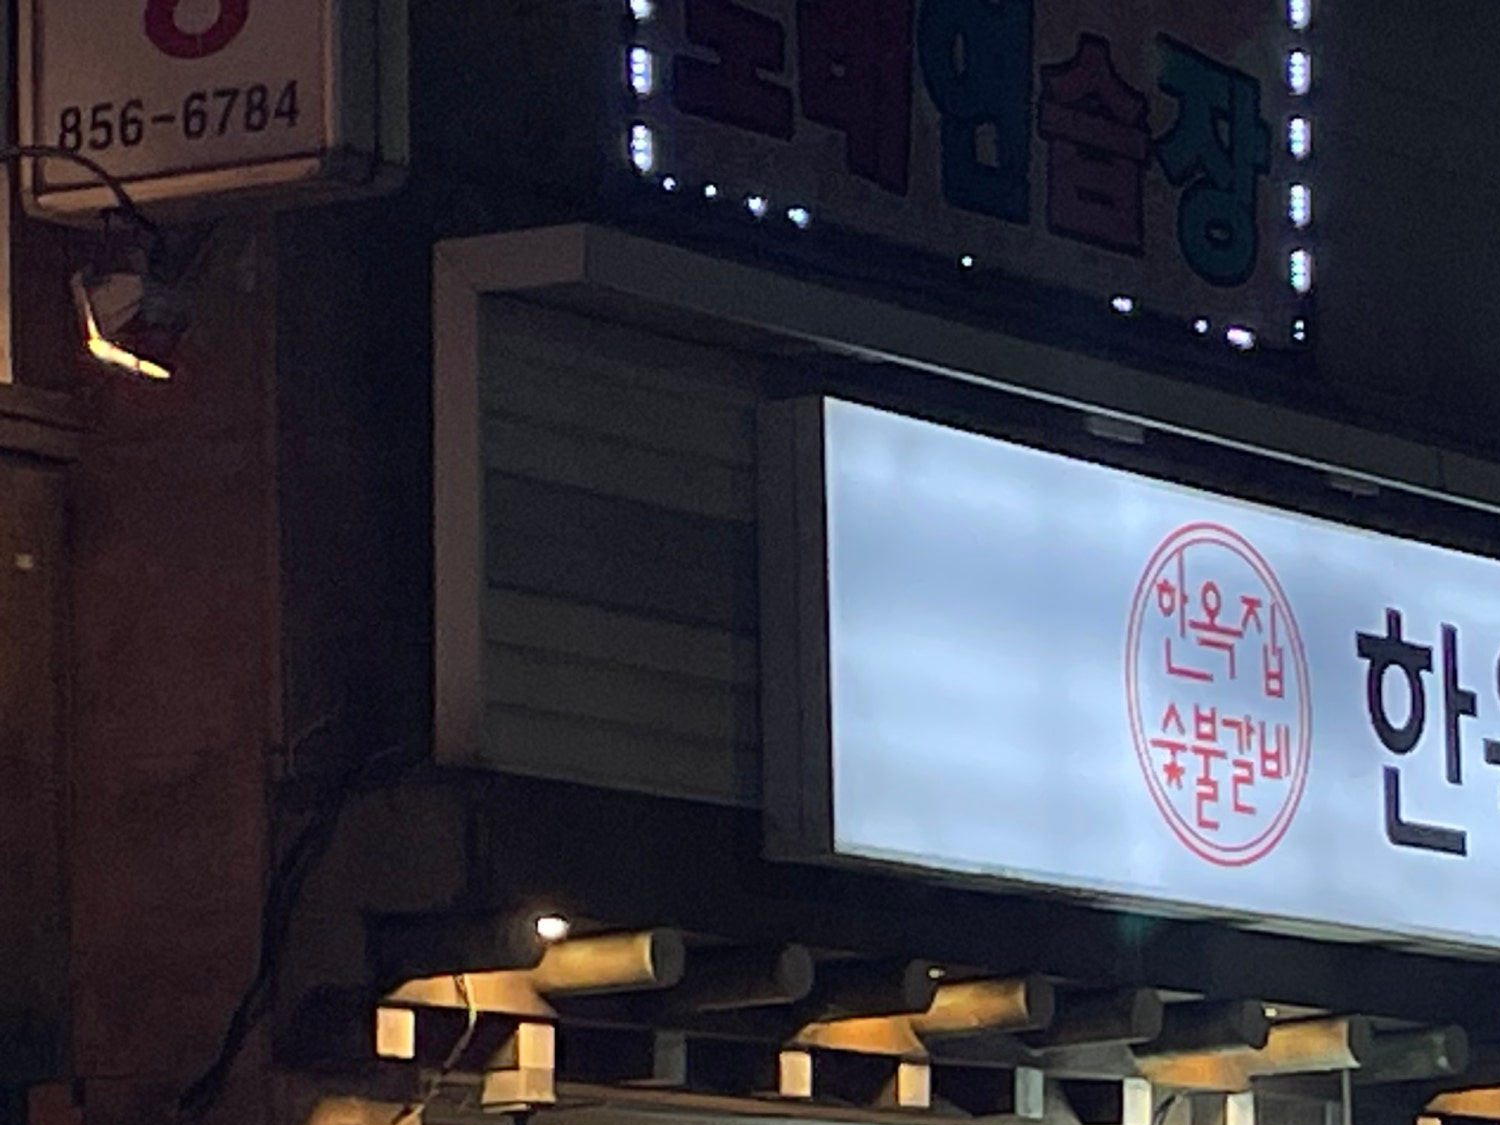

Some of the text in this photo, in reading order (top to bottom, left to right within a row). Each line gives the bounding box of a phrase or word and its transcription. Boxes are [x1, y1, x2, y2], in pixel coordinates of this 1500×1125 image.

[57, 79, 302, 152] 856-6784
[1155, 547, 1285, 699] 한옥집
[1149, 701, 1291, 831] 숯불갈비
